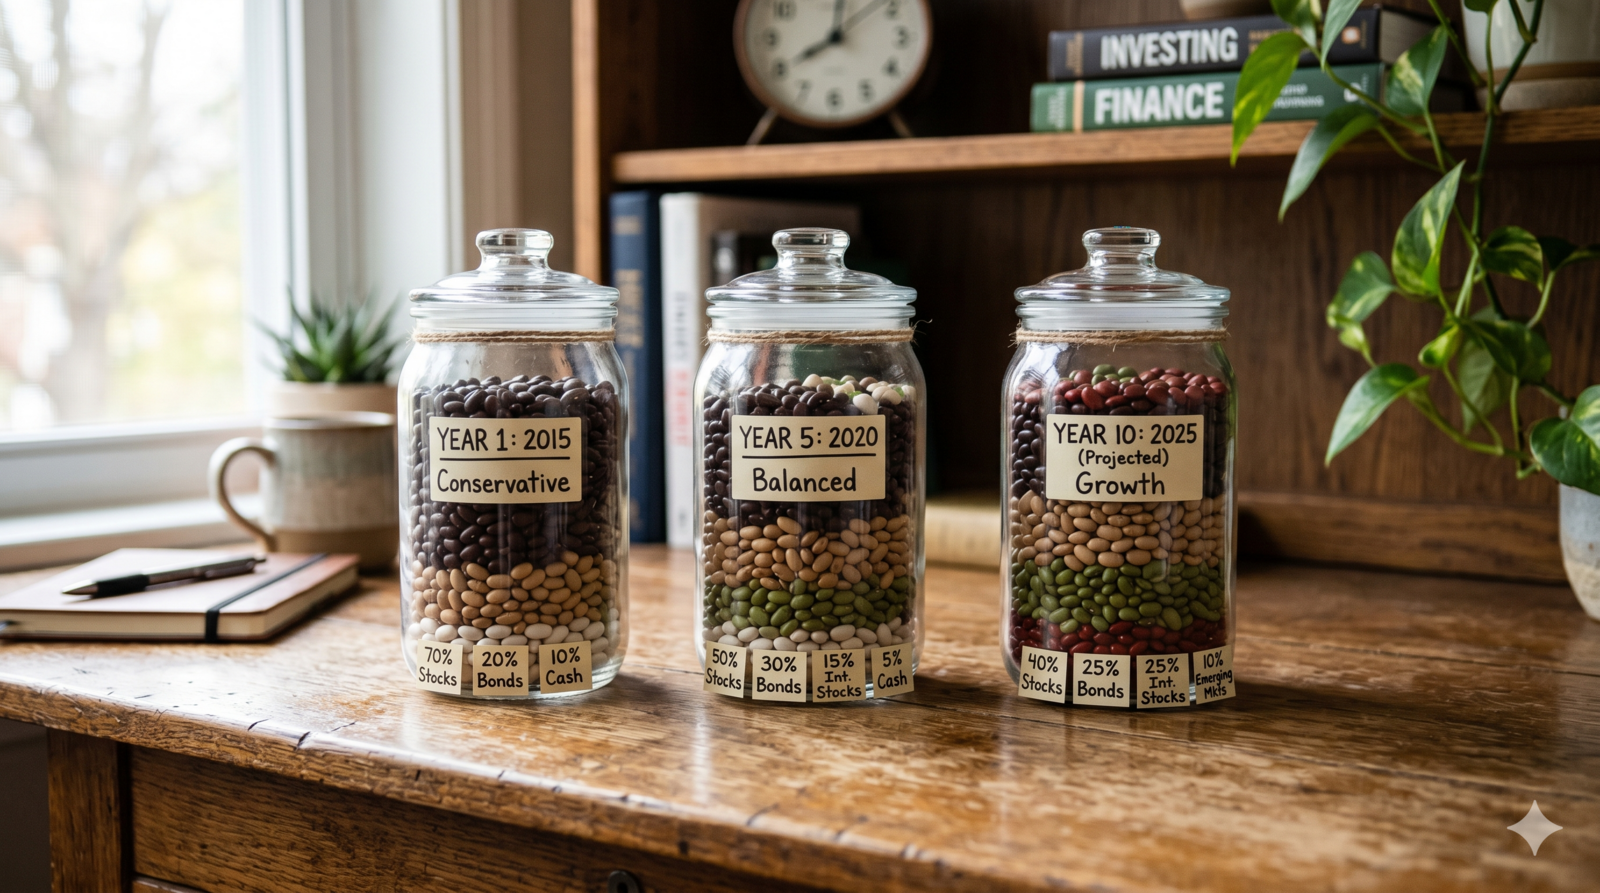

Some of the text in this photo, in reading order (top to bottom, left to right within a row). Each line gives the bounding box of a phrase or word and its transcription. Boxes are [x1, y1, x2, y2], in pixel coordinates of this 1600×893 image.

[764, 27, 780, 46] 9
[894, 25, 909, 48] 3
[1100, 27, 1239, 70] INVESTING
[772, 59, 787, 80] 8
[883, 57, 898, 77] 4
[797, 78, 811, 101] 7
[826, 88, 843, 110] 6
[858, 78, 874, 102] 5
[1094, 82, 1225, 125] FINANCE
[437, 427, 488, 451] YEAR
[524, 428, 571, 450] 2015
[739, 425, 793, 449] YEAR
[829, 426, 878, 448] 2020
[1053, 423, 1107, 444] YEAR
[1150, 423, 1197, 444] 2025
[1078, 448, 1169, 469] (Projected)
[437, 469, 570, 494] Conservative
[753, 467, 856, 492] Balanced
[1076, 471, 1165, 495] Growth
[424, 646, 452, 665] 70%
[482, 651, 518, 667] 20%
[551, 646, 580, 665] 10%
[712, 648, 738, 668] 50%
[761, 656, 797, 672] 30%
[824, 652, 854, 668] 15%
[882, 649, 903, 667] 5%
[1028, 653, 1059, 673] 40%
[1203, 650, 1224, 669] 10%
[1082, 659, 1120, 677] 25%
[1145, 658, 1180, 674] 25%
[418, 667, 457, 686] Stocks
[477, 672, 523, 688] Bonds
[546, 668, 583, 685] Cash
[705, 667, 742, 690] Stocks
[756, 676, 802, 694] Bonds
[824, 671, 851, 683] Int.
[877, 670, 908, 689] Cash
[1021, 673, 1063, 695] Stocks
[1149, 676, 1176, 689] Int.
[1196, 670, 1233, 686] Emerging
[816, 684, 862, 699] Stocks
[1078, 680, 1124, 699] Bonds
[1141, 691, 1186, 705] Stocks
[1204, 686, 1227, 700] Mkts
